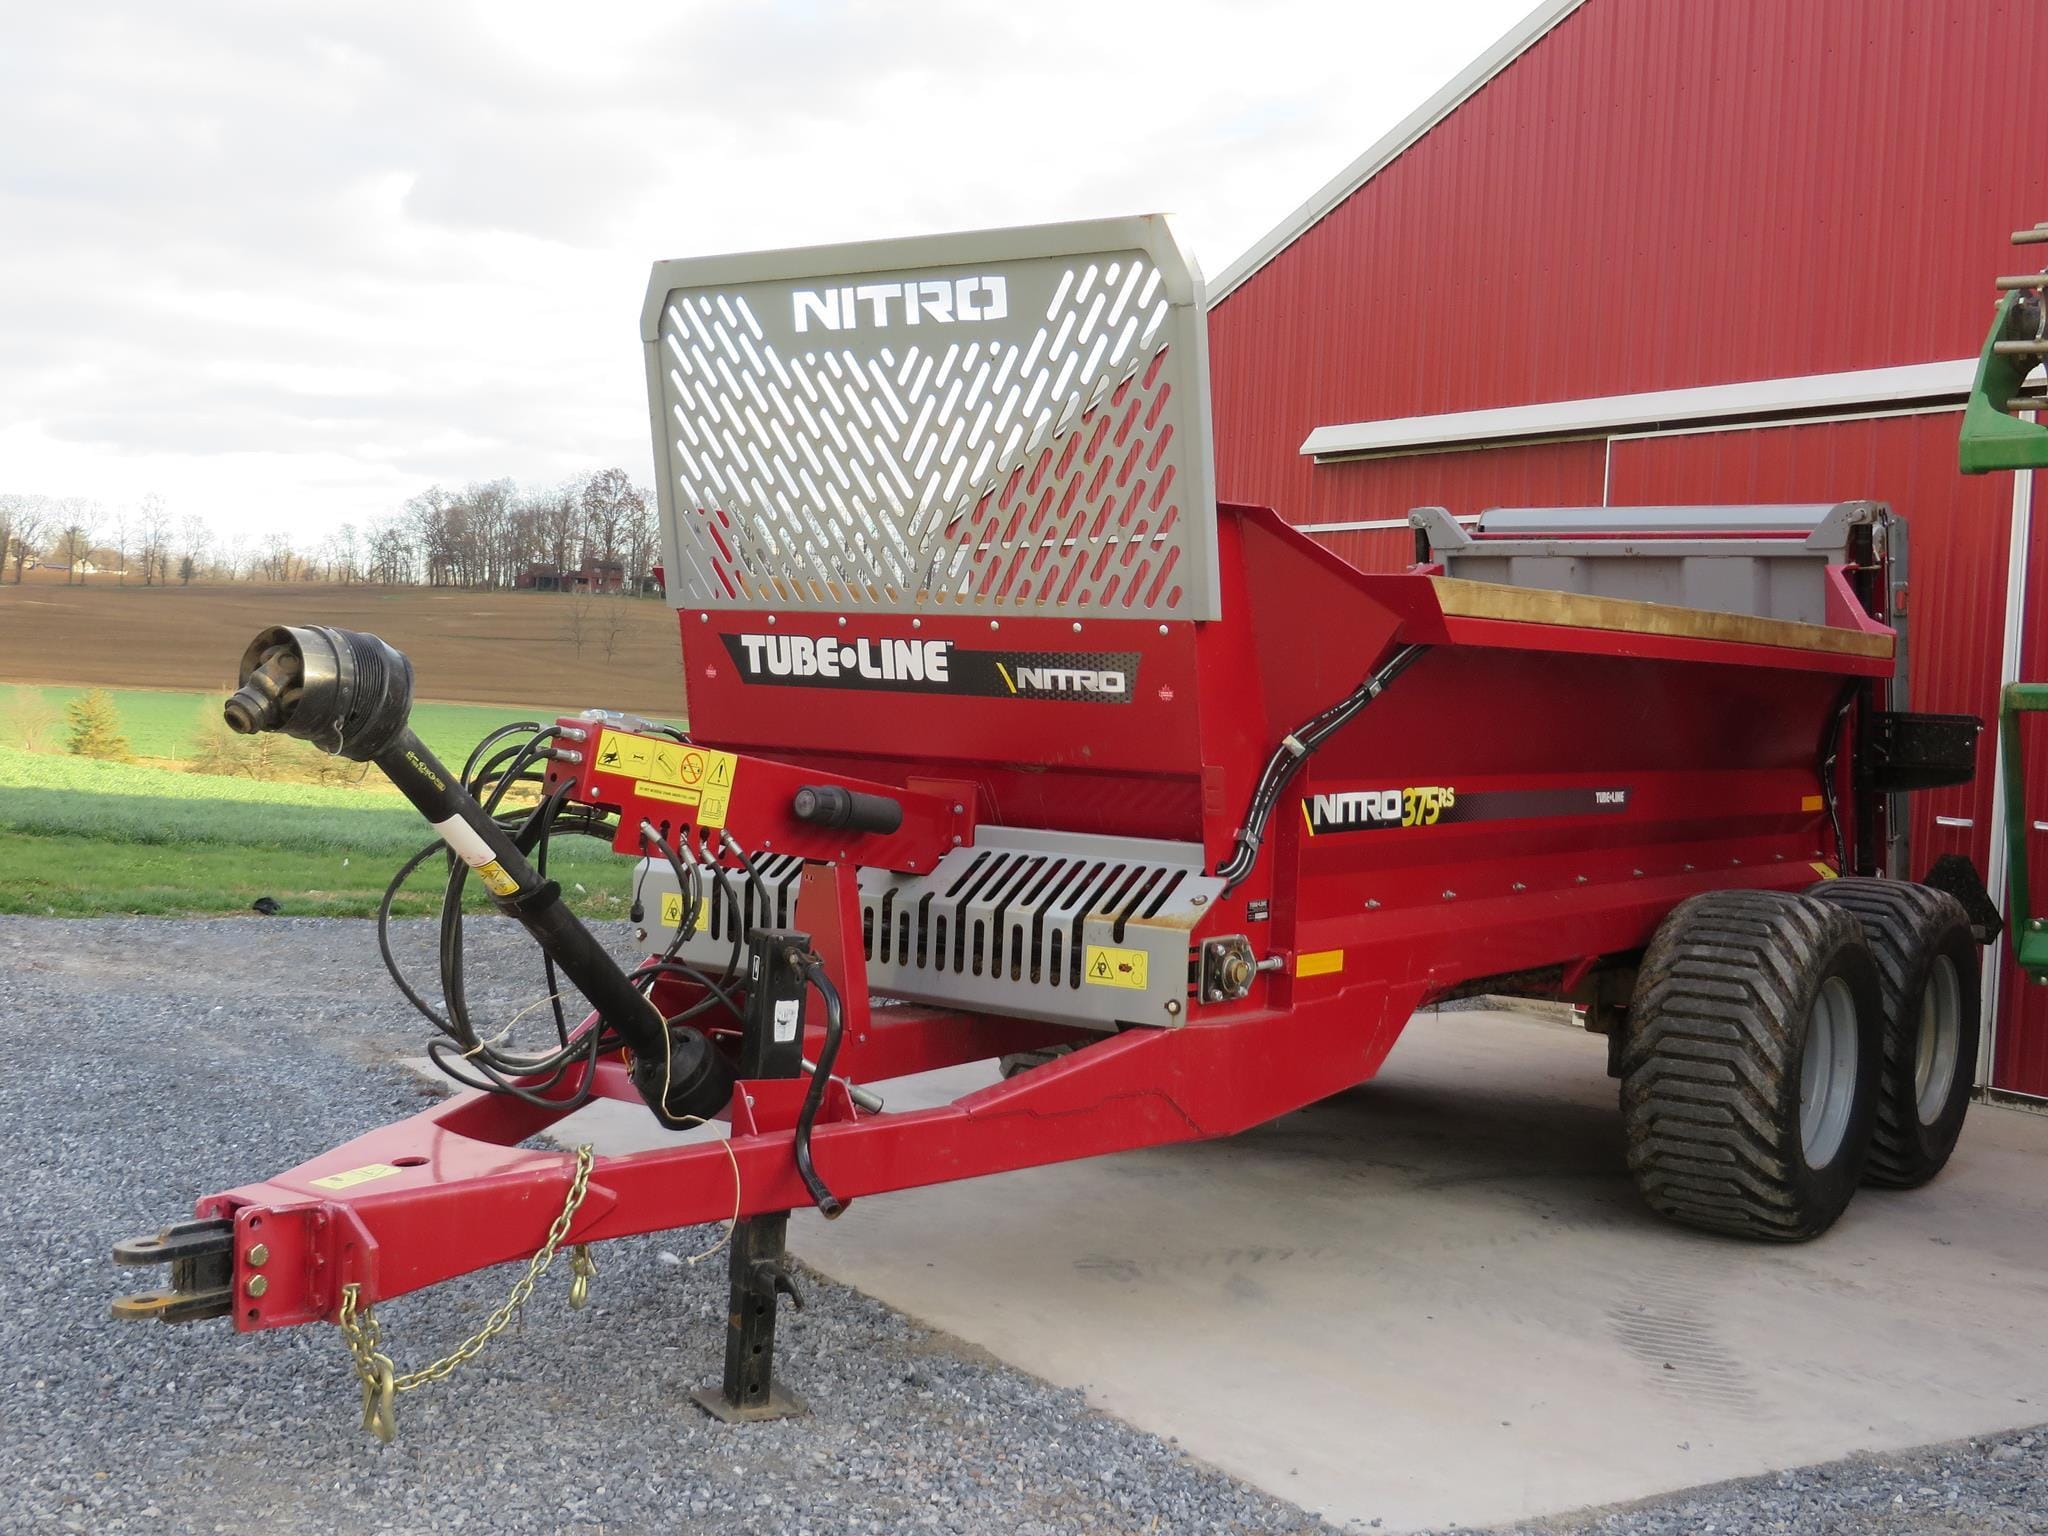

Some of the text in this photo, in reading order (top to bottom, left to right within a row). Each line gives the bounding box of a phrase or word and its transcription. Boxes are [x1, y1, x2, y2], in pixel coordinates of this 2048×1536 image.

[792, 276, 1008, 333] NITRO
[1016, 666, 1127, 694] NITRO
[1313, 789, 1402, 825] NITRO
